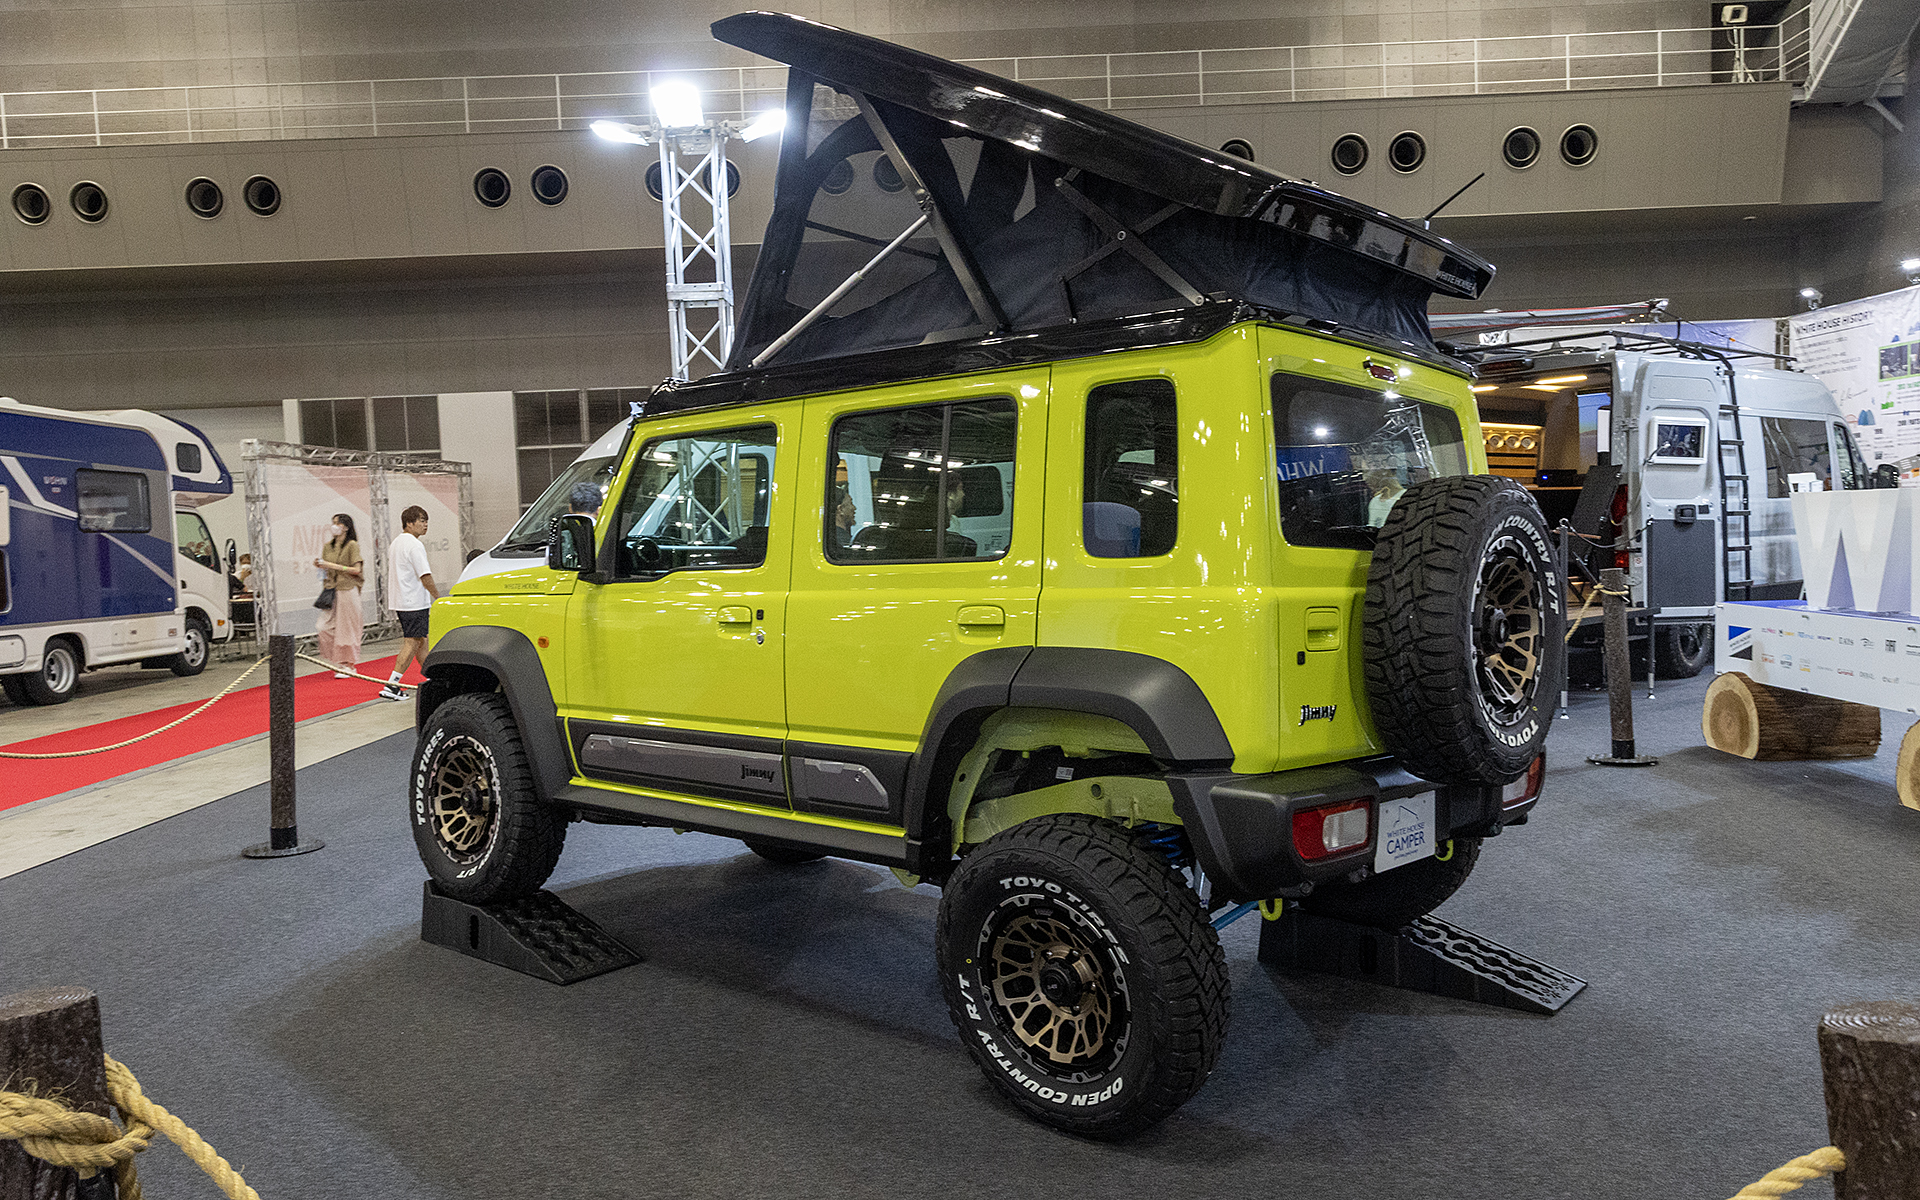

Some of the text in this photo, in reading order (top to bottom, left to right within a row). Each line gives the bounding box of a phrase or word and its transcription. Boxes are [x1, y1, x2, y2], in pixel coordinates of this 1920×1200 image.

[1795, 311, 1874, 335] WHITE HOUSE HISTORY
[1504, 515, 1550, 562] COUNTRY
[1545, 571, 1560, 614] R/T
[522, 582, 539, 590] HOUSE
[1298, 704, 1337, 727] Jimny
[1507, 719, 1539, 747] TOYO
[415, 728, 445, 826] TOYO TIRES
[741, 764, 775, 783] Jimny
[1387, 822, 1425, 837] WHITE HOUSE
[1386, 831, 1425, 854] CAMPER
[999, 876, 1130, 965] TOYO TIRES
[958, 973, 1124, 1106] OPEN COUNTRY R/T
